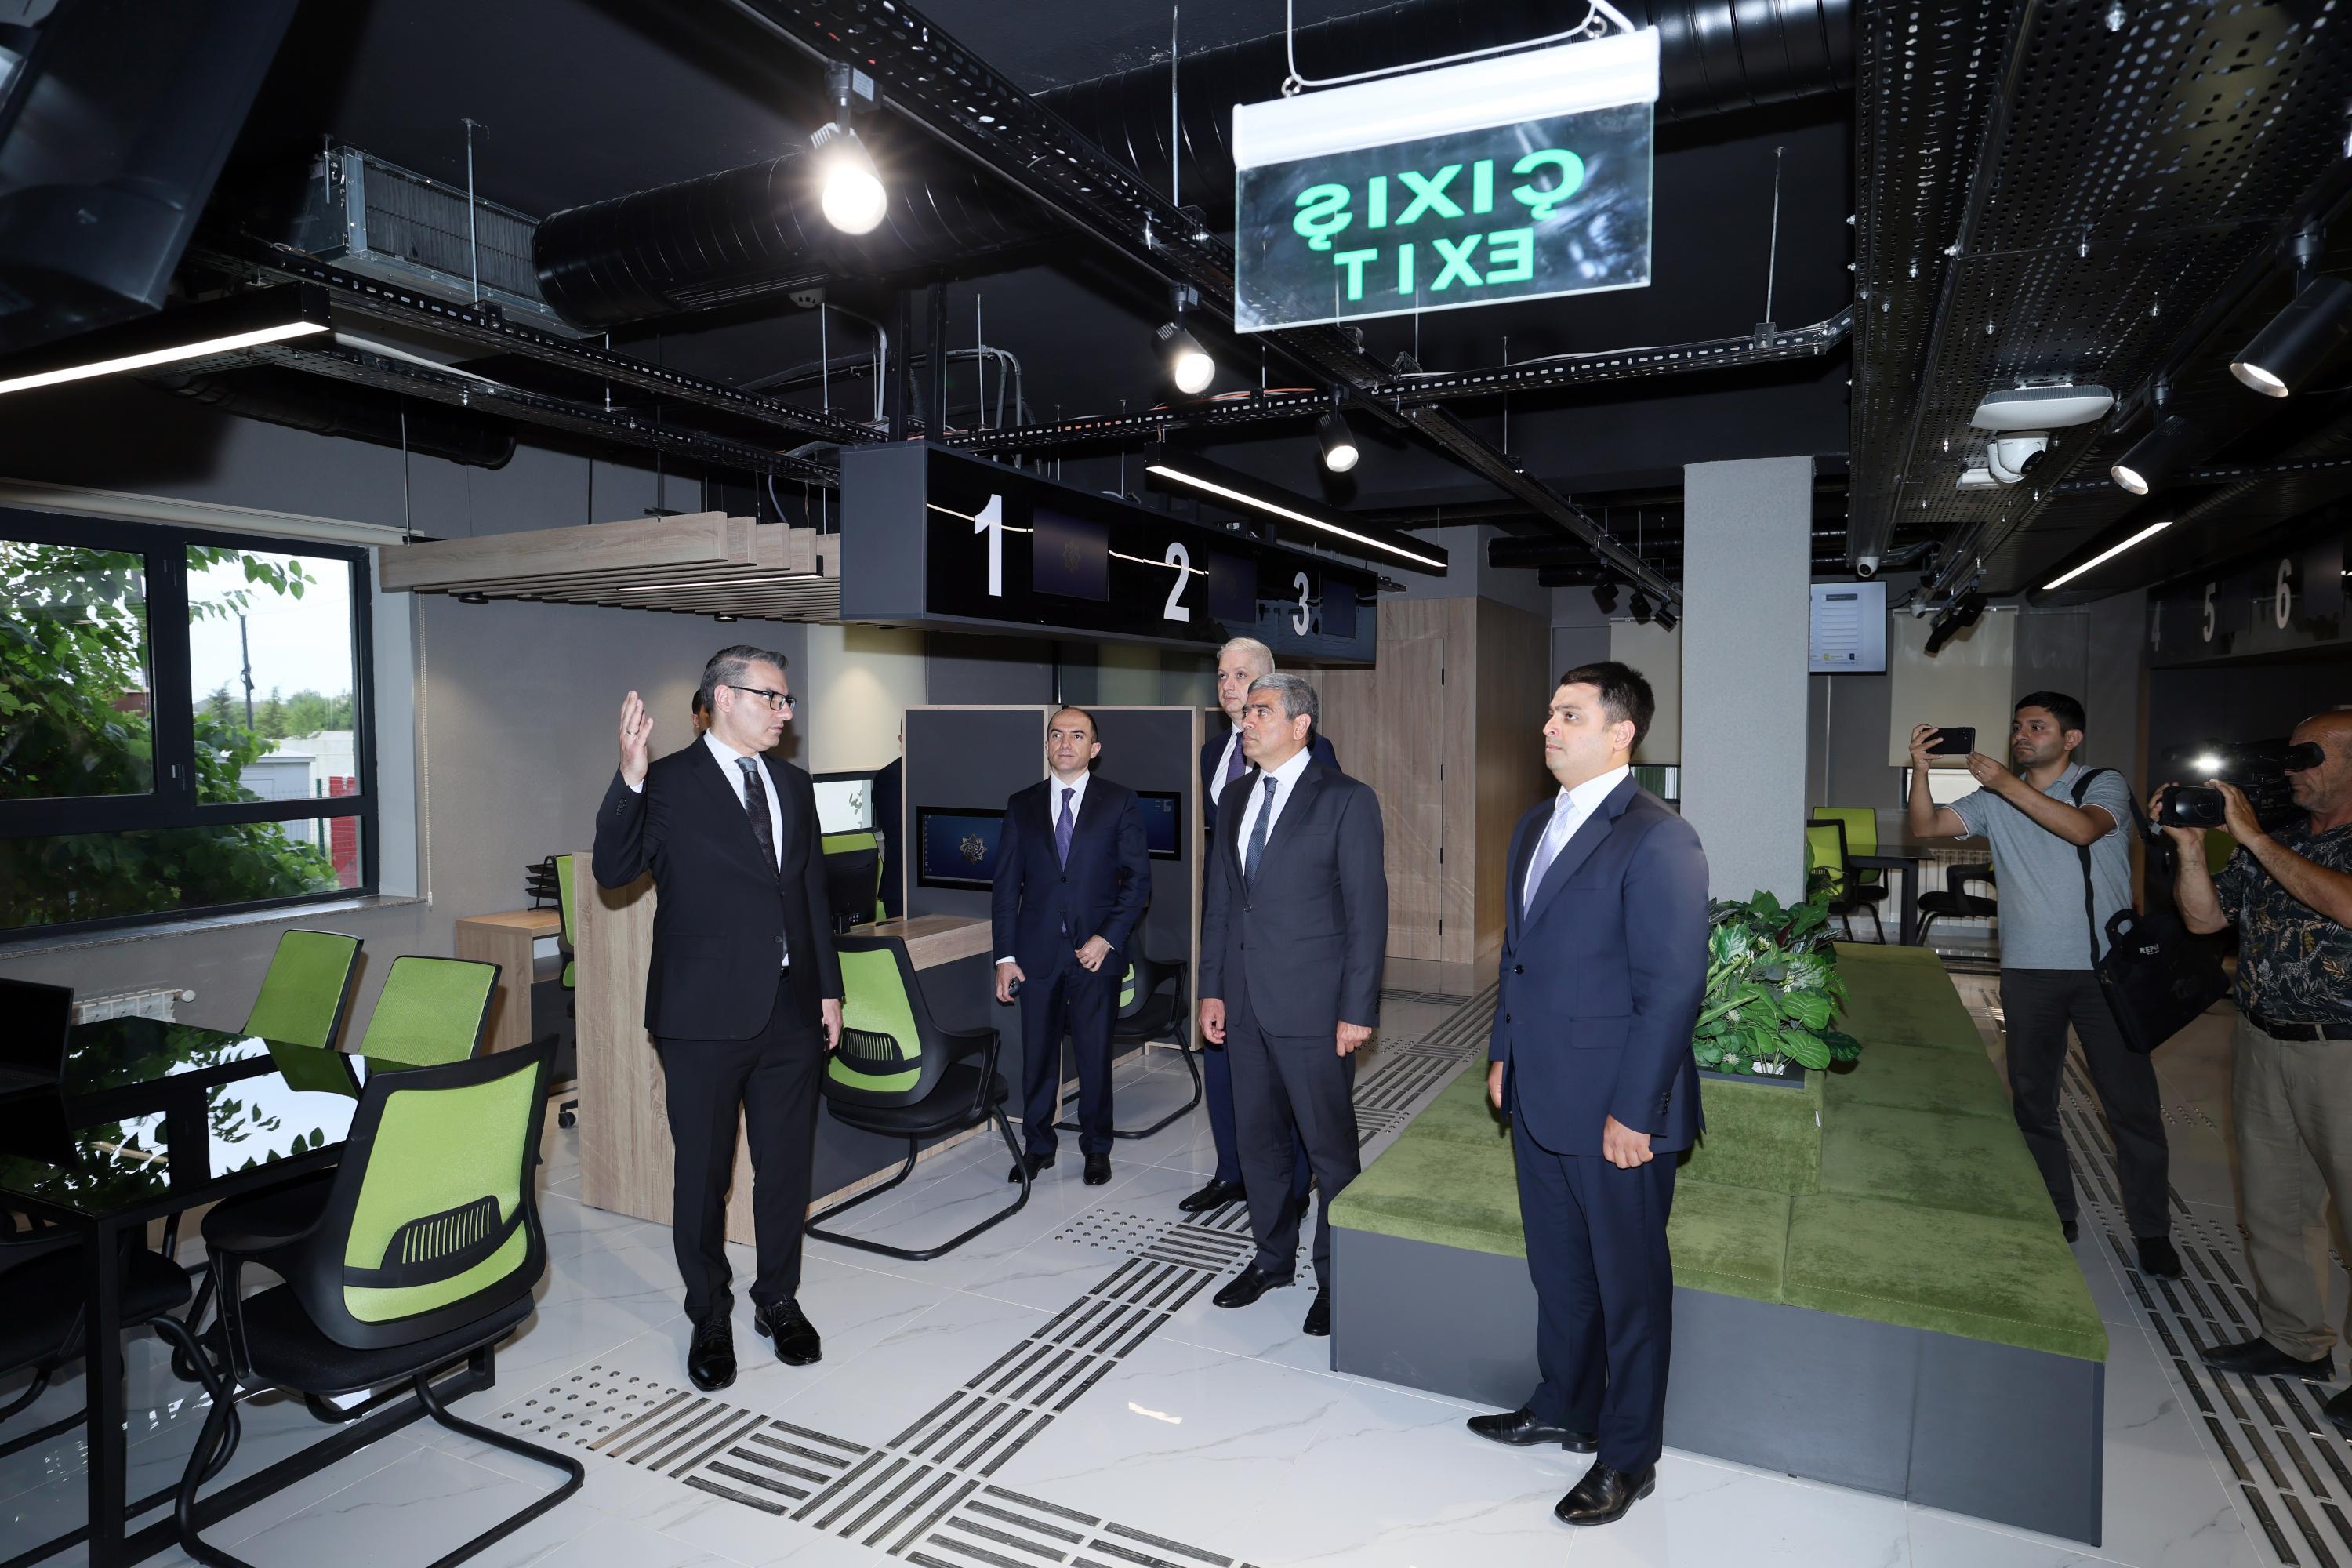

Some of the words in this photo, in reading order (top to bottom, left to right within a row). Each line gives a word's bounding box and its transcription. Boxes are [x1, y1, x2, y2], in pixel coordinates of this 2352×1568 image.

[974, 493, 1003, 597] 1
[1163, 542, 1190, 622] 2
[1292, 572, 1310, 637] 3
[2203, 582, 2216, 643] 5
[2275, 558, 2292, 630] 6
[2151, 601, 2161, 652] 4
